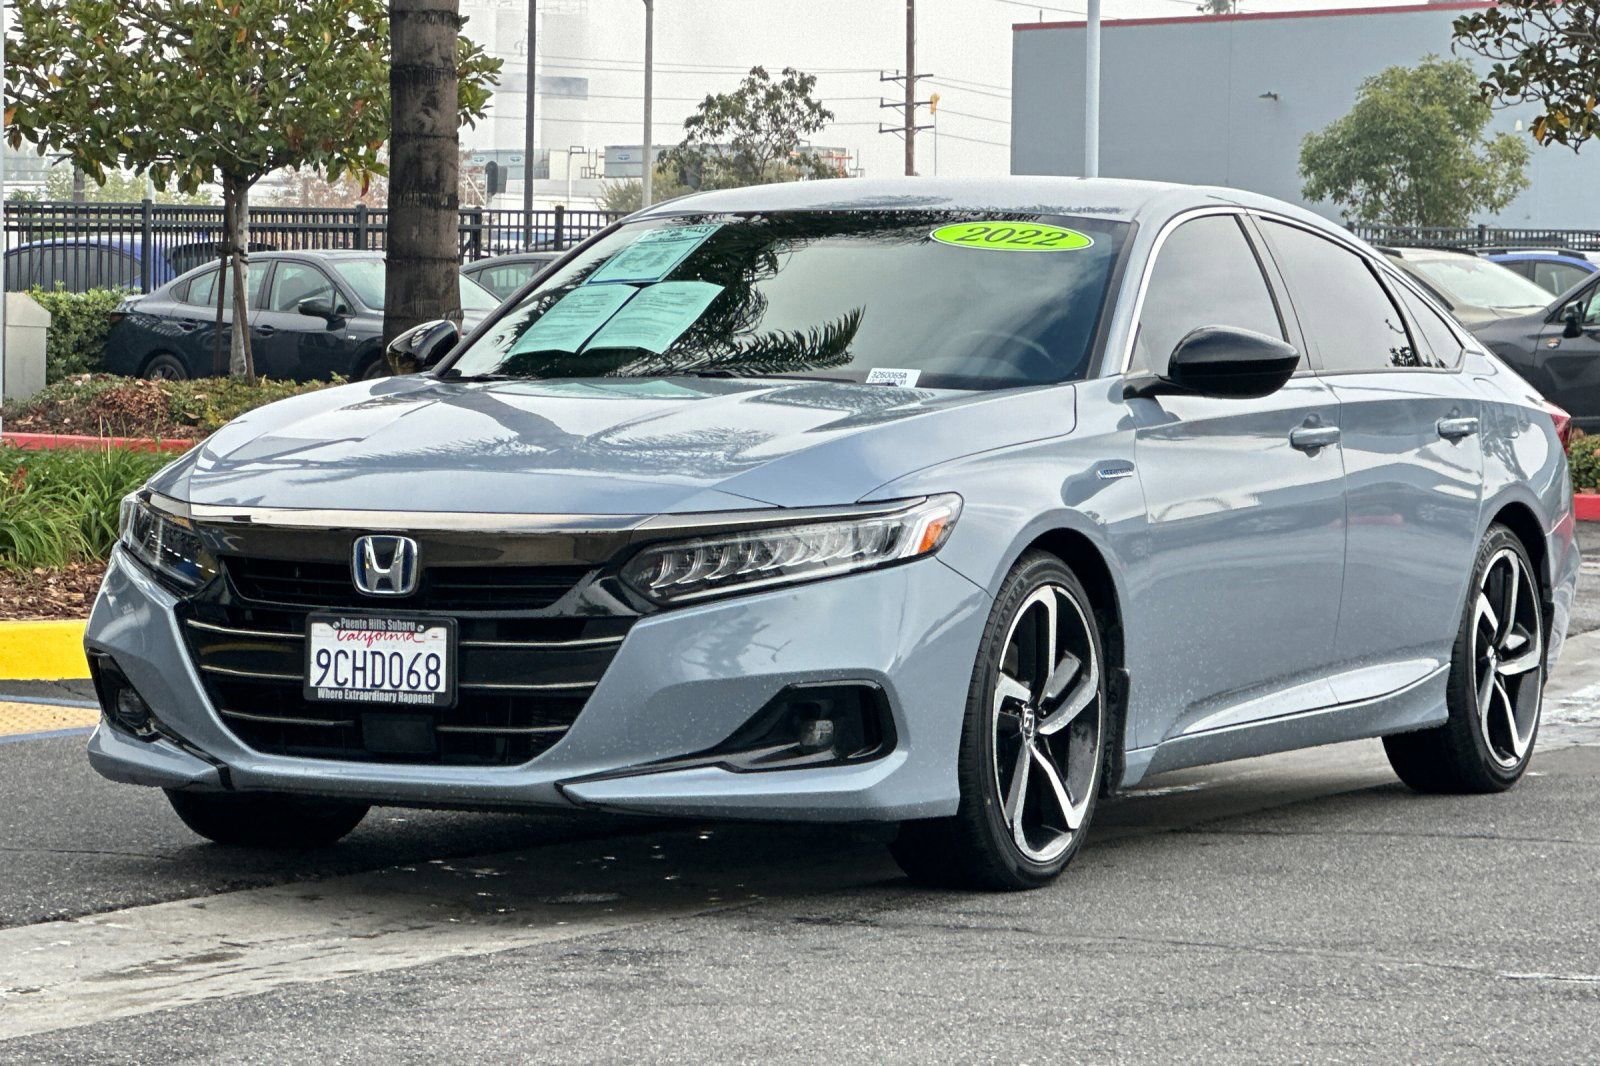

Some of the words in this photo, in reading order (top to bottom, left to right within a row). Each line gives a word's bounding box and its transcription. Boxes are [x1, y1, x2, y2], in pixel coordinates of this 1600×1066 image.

[954, 226, 1069, 246] 2022
[341, 617, 368, 630] Puente
[368, 618, 386, 630] Hills
[387, 619, 416, 631] Subaru
[336, 629, 425, 648] California
[314, 648, 441, 691] 9CHD068
[317, 688, 343, 699] Where
[344, 690, 397, 703] Extraordinary
[398, 692, 435, 704] Happens!
